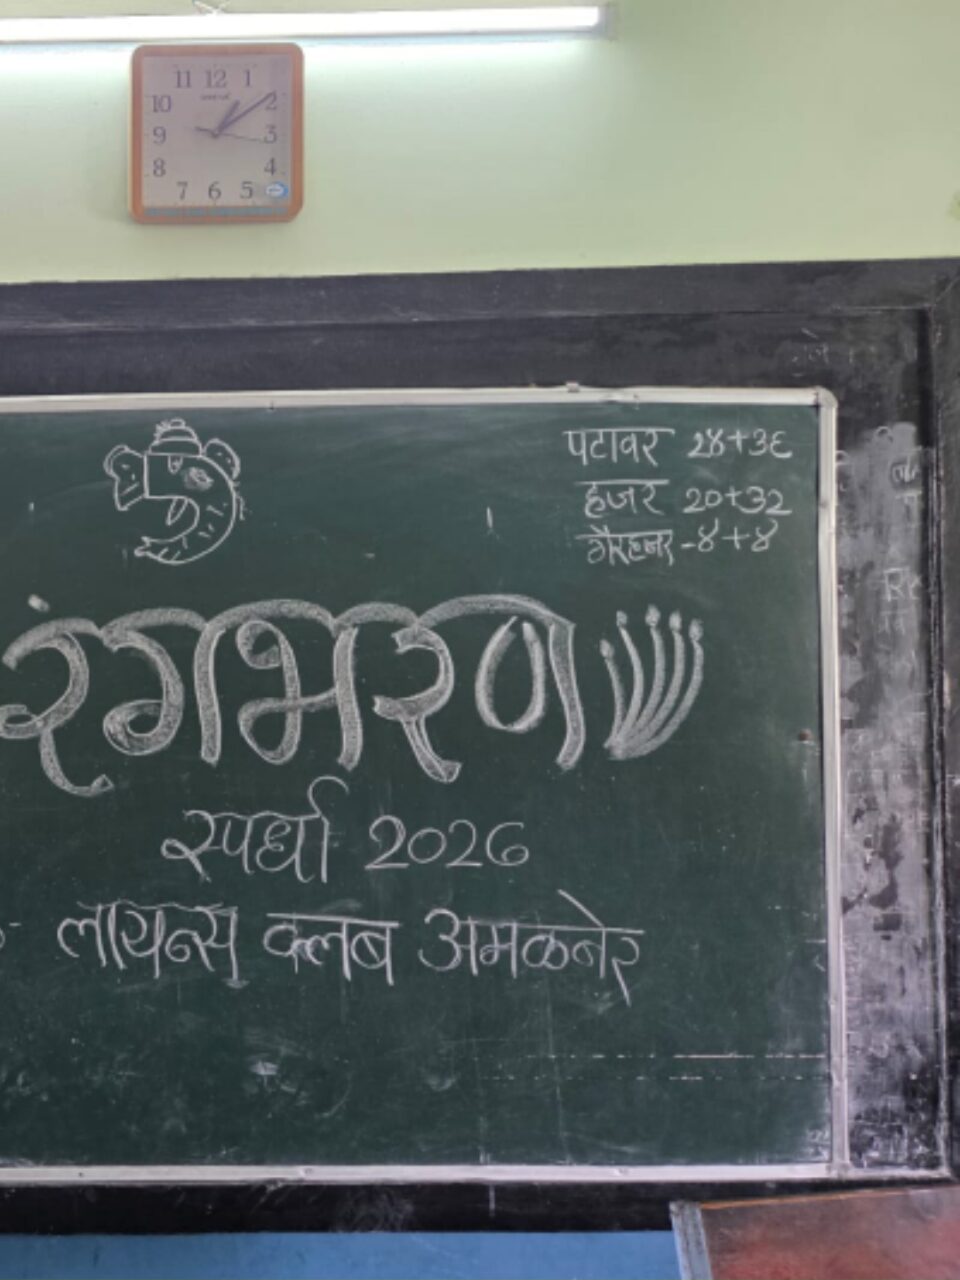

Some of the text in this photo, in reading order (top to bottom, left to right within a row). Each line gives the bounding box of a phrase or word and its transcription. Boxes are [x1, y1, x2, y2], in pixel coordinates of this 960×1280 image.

[176, 69, 193, 88] 11
[204, 69, 227, 88] 12
[245, 69, 251, 87] 1
[151, 94, 172, 113] 10
[152, 126, 167, 144] 9
[264, 125, 278, 144] 3
[152, 158, 167, 177] 8
[264, 157, 277, 176] 4
[177, 181, 189, 199] 7
[208, 181, 222, 200] 6
[240, 181, 254, 199] 5
